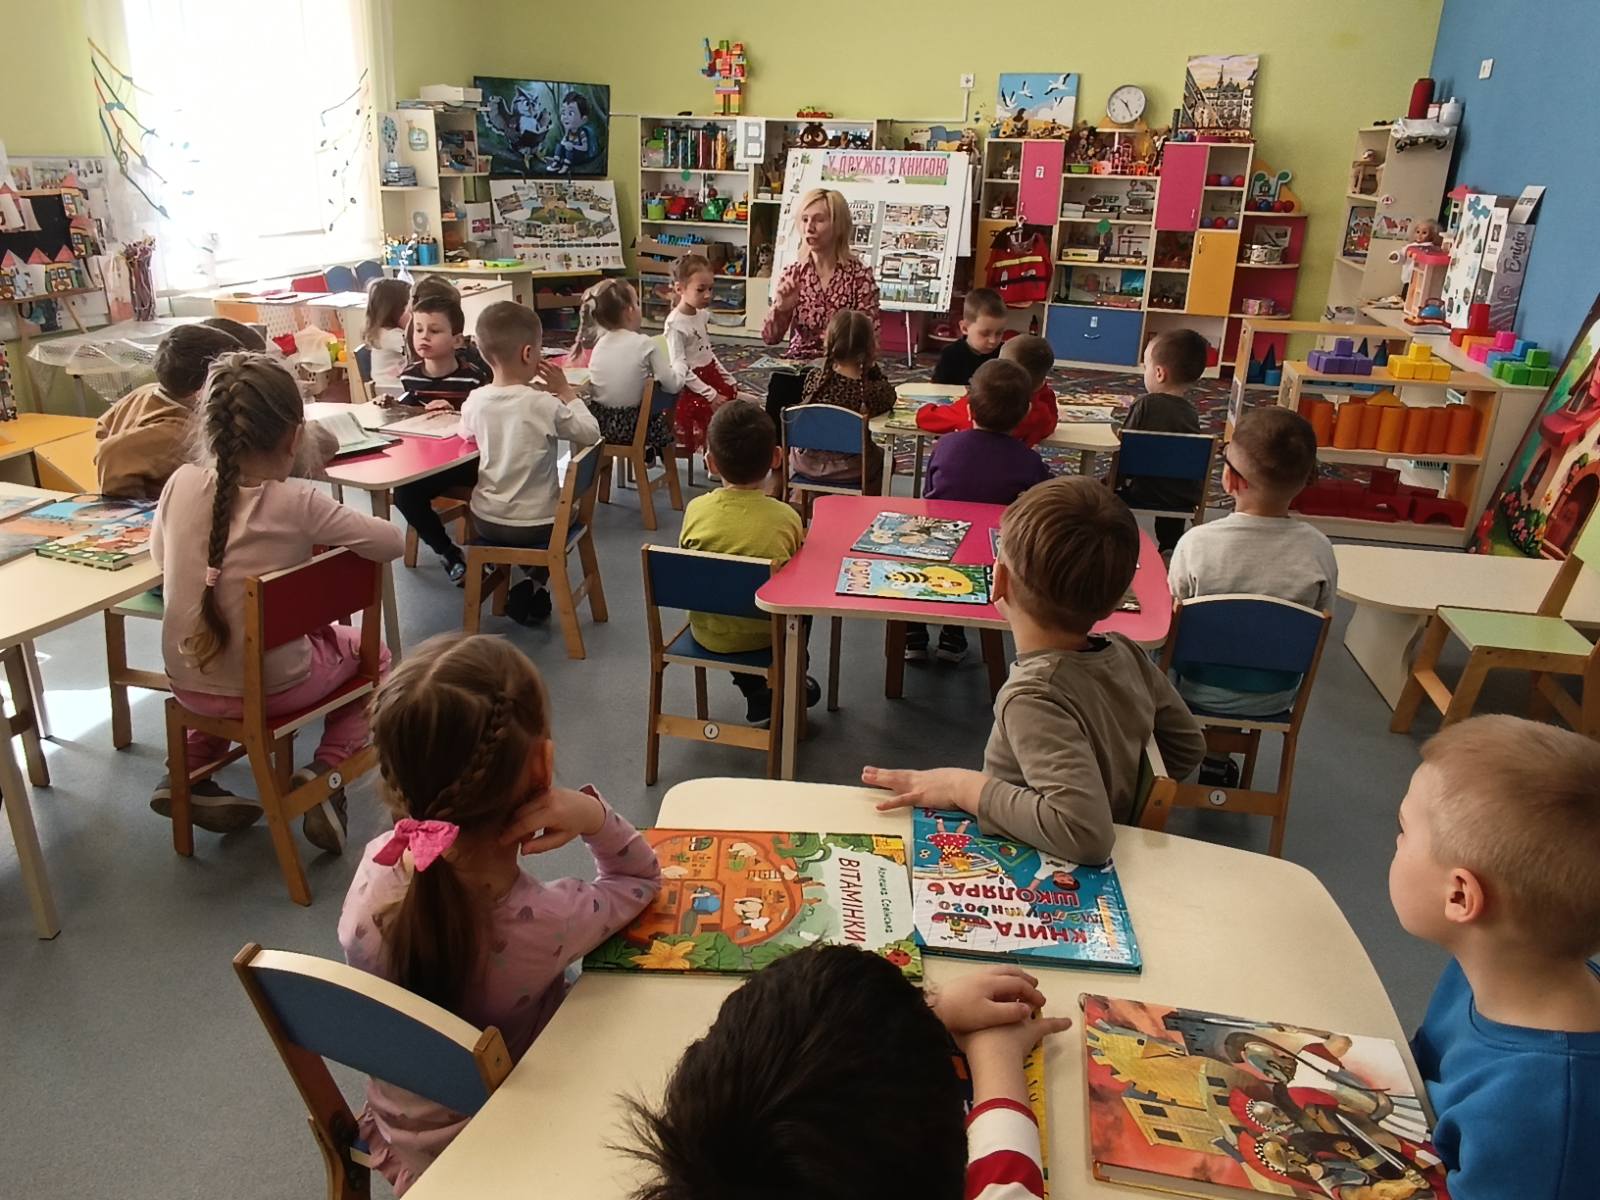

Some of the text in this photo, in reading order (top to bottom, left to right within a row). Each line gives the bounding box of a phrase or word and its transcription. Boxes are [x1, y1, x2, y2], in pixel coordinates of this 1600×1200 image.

[828, 156, 948, 176] У ДРУЖБІ З КНИГОЮ
[838, 857, 867, 942] ВІТАМІНКИ
[948, 882, 1079, 907] ШКОЛЯРА
[993, 919, 1087, 944] КНИГА
